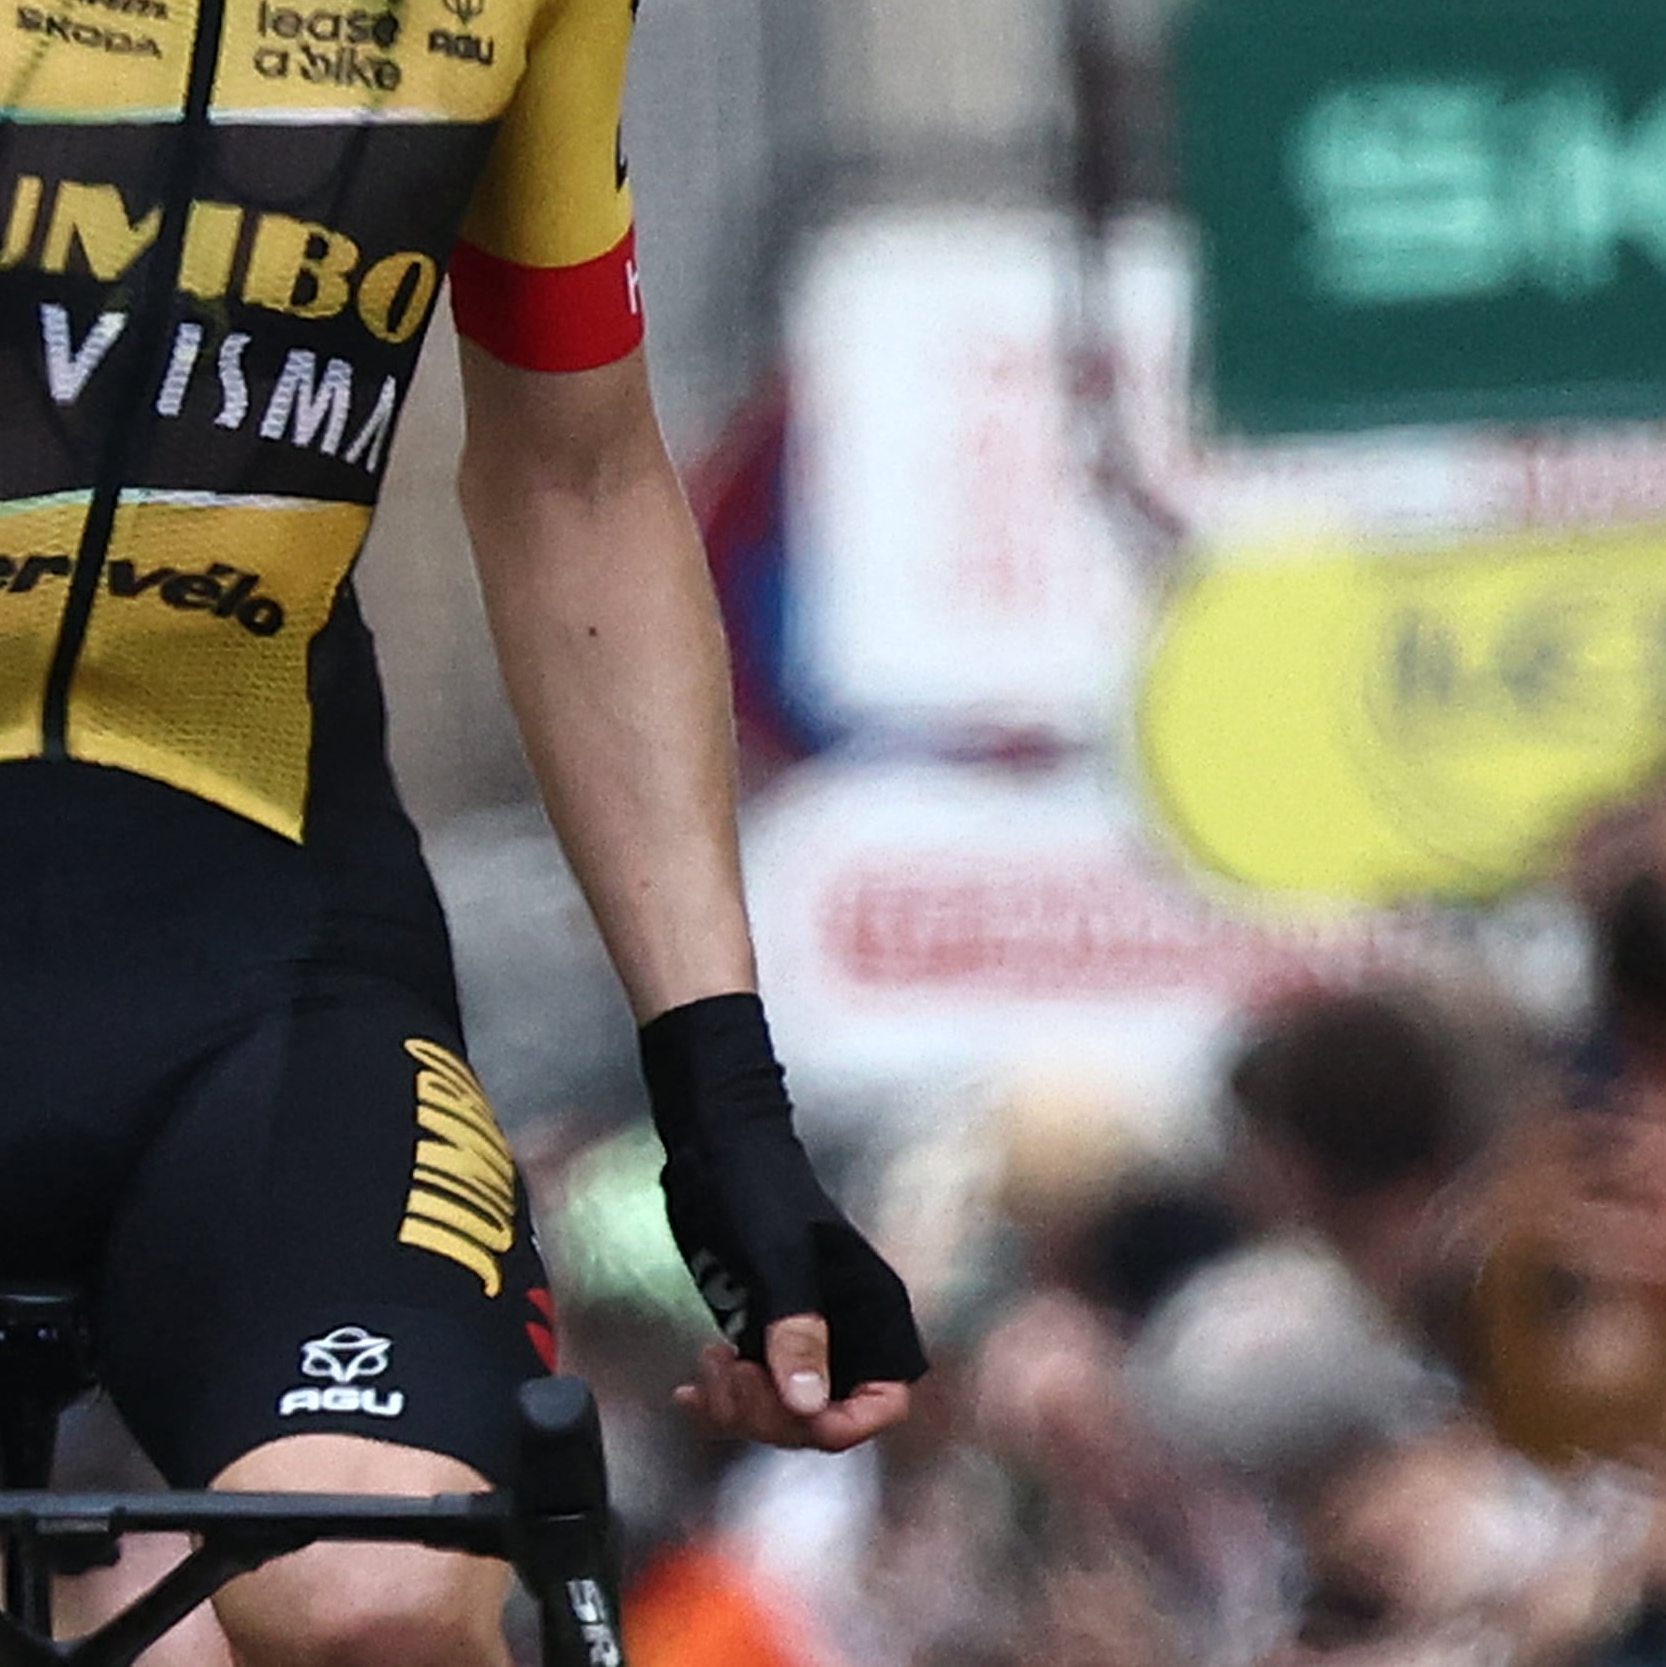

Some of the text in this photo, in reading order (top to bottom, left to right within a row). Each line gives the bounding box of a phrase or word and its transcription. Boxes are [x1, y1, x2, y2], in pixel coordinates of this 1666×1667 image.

[258, 0, 400, 48] lease
[39, 300, 397, 474] VISMA
[278, 1385, 405, 1417] AGU
